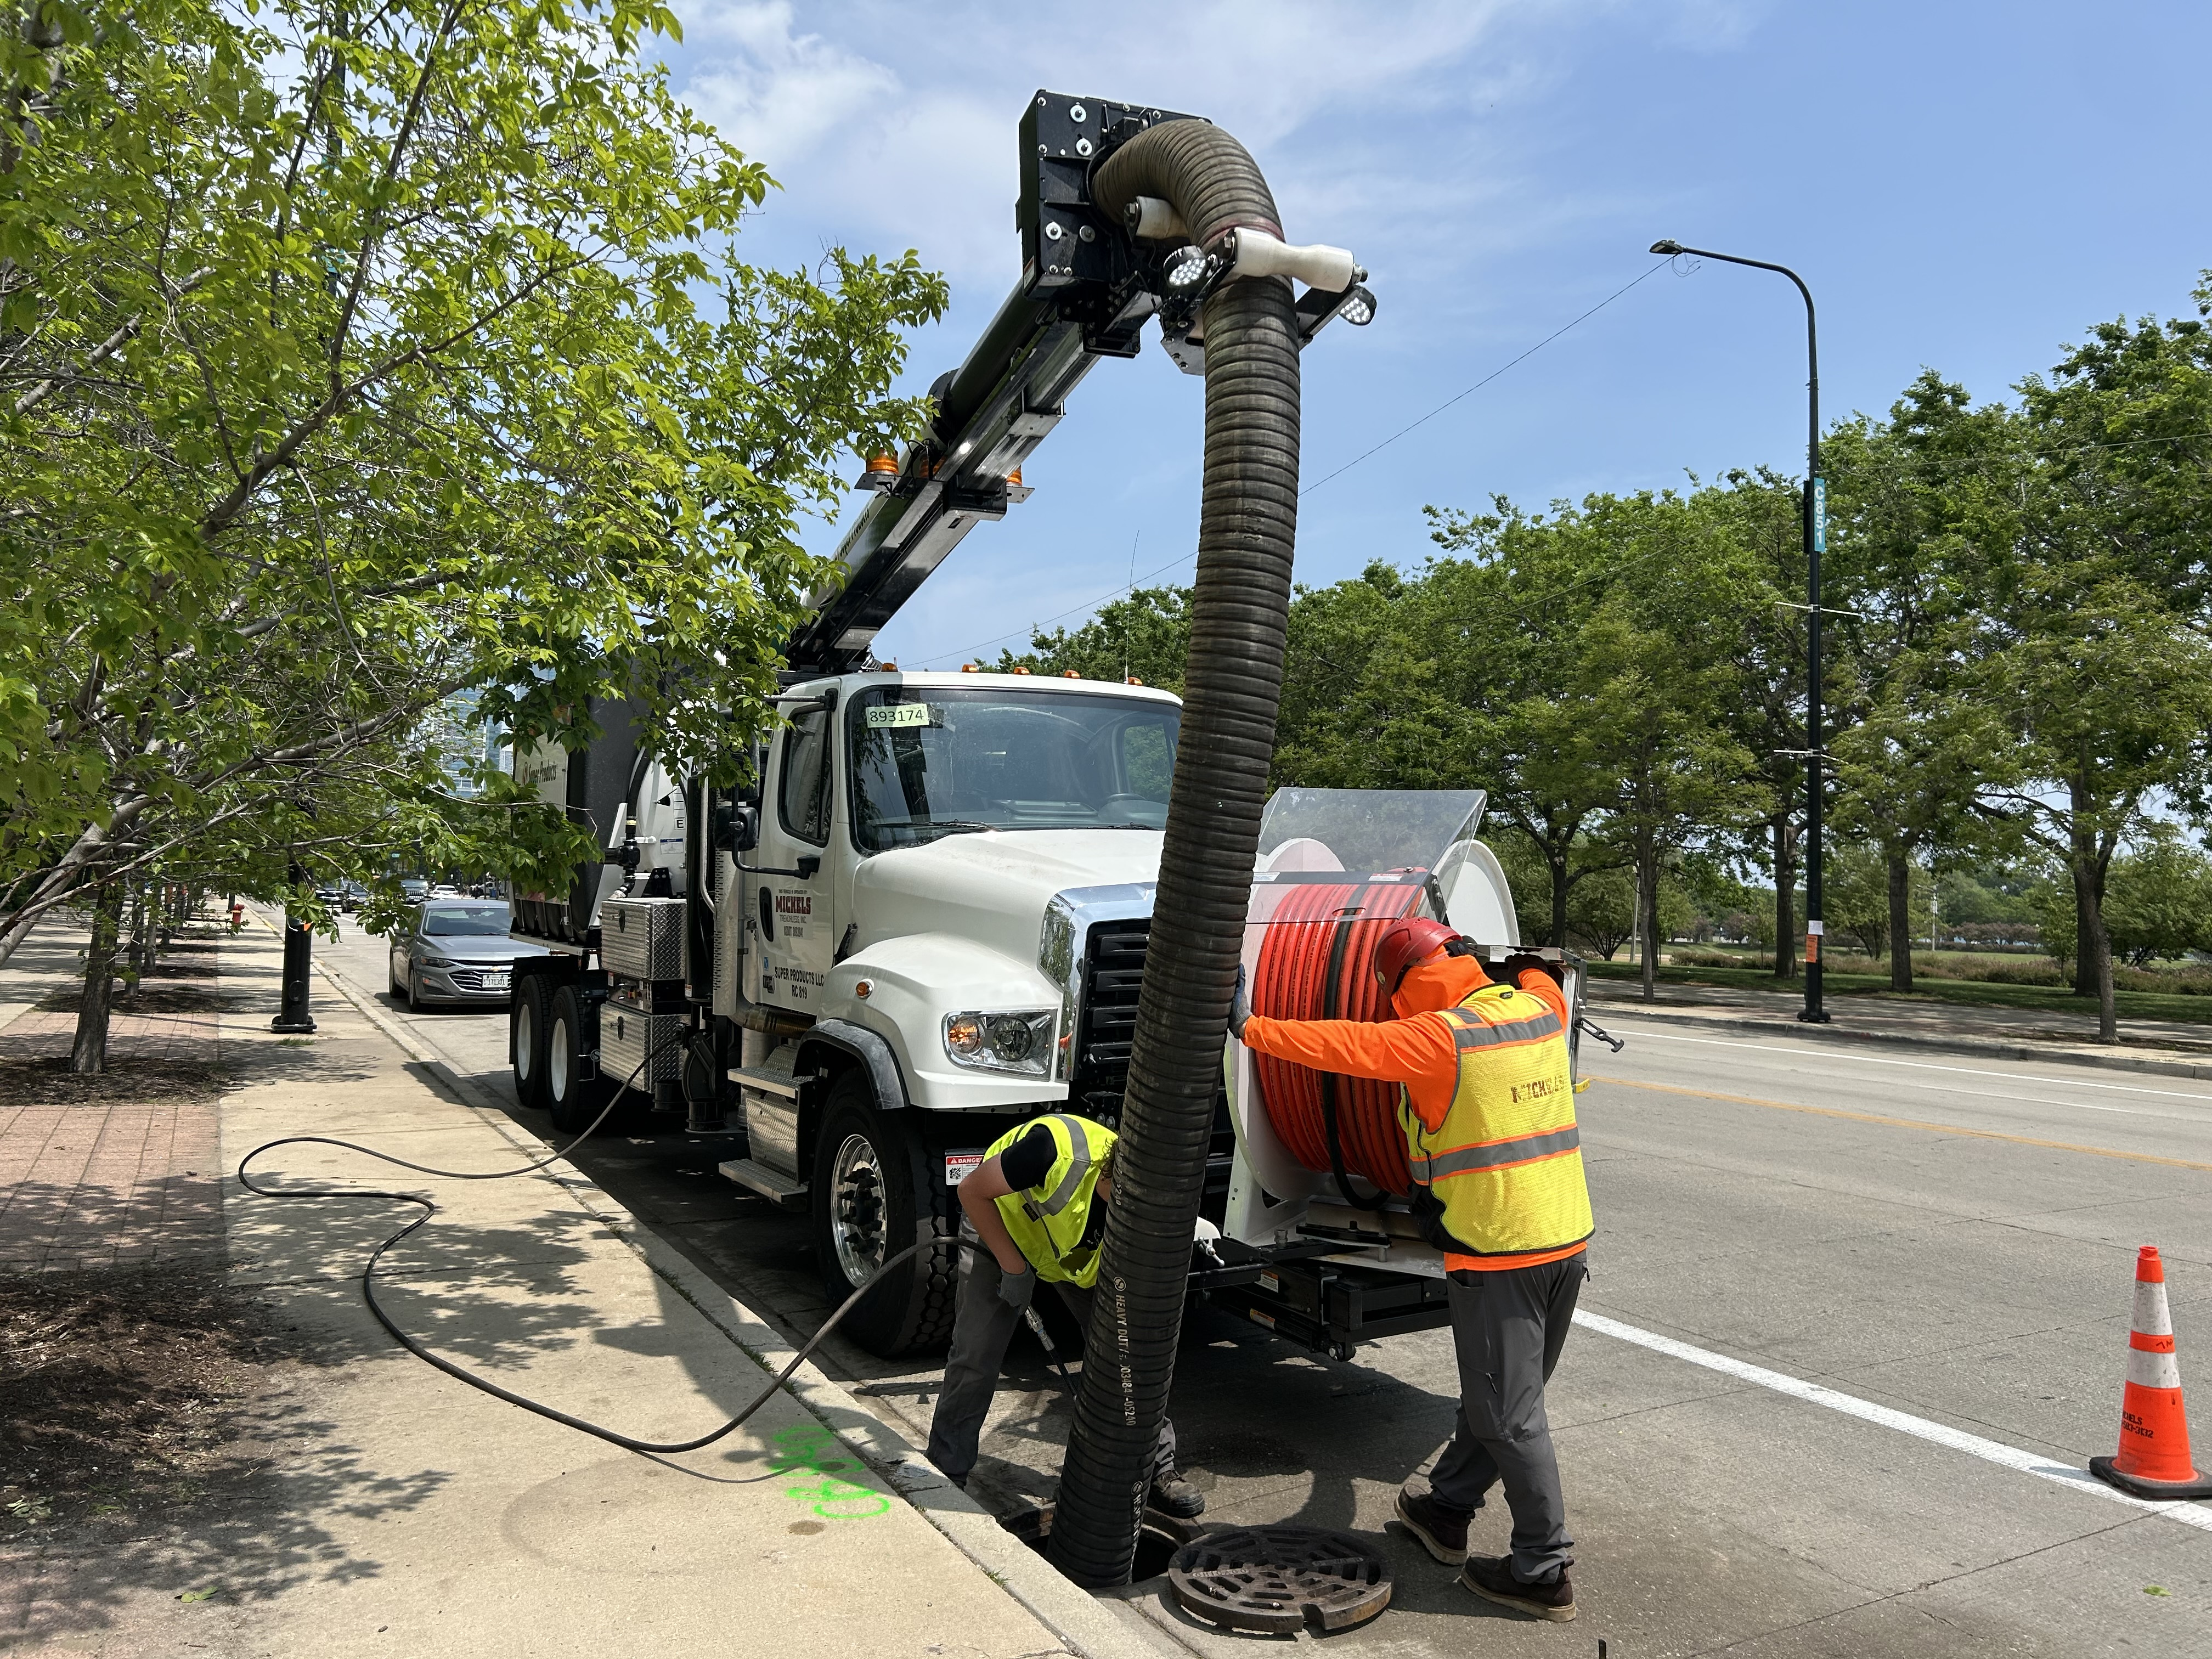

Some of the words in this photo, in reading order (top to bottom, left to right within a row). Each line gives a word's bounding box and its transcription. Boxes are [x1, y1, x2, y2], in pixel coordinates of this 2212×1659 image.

[1815, 486, 1824, 544] C851
[870, 709, 924, 723] 893174
[676, 820, 684, 828] E
[776, 895, 811, 915] MICHELS
[775, 966, 789, 980] SUPER
[790, 969, 815, 985] PRODUCTS
[815, 973, 824, 986] LLC
[792, 985, 798, 997] RC
[799, 986, 808, 999] 819
[1116, 1295, 1127, 1325] HEAVY
[1195, 1569, 1246, 1577] CHICAGO
